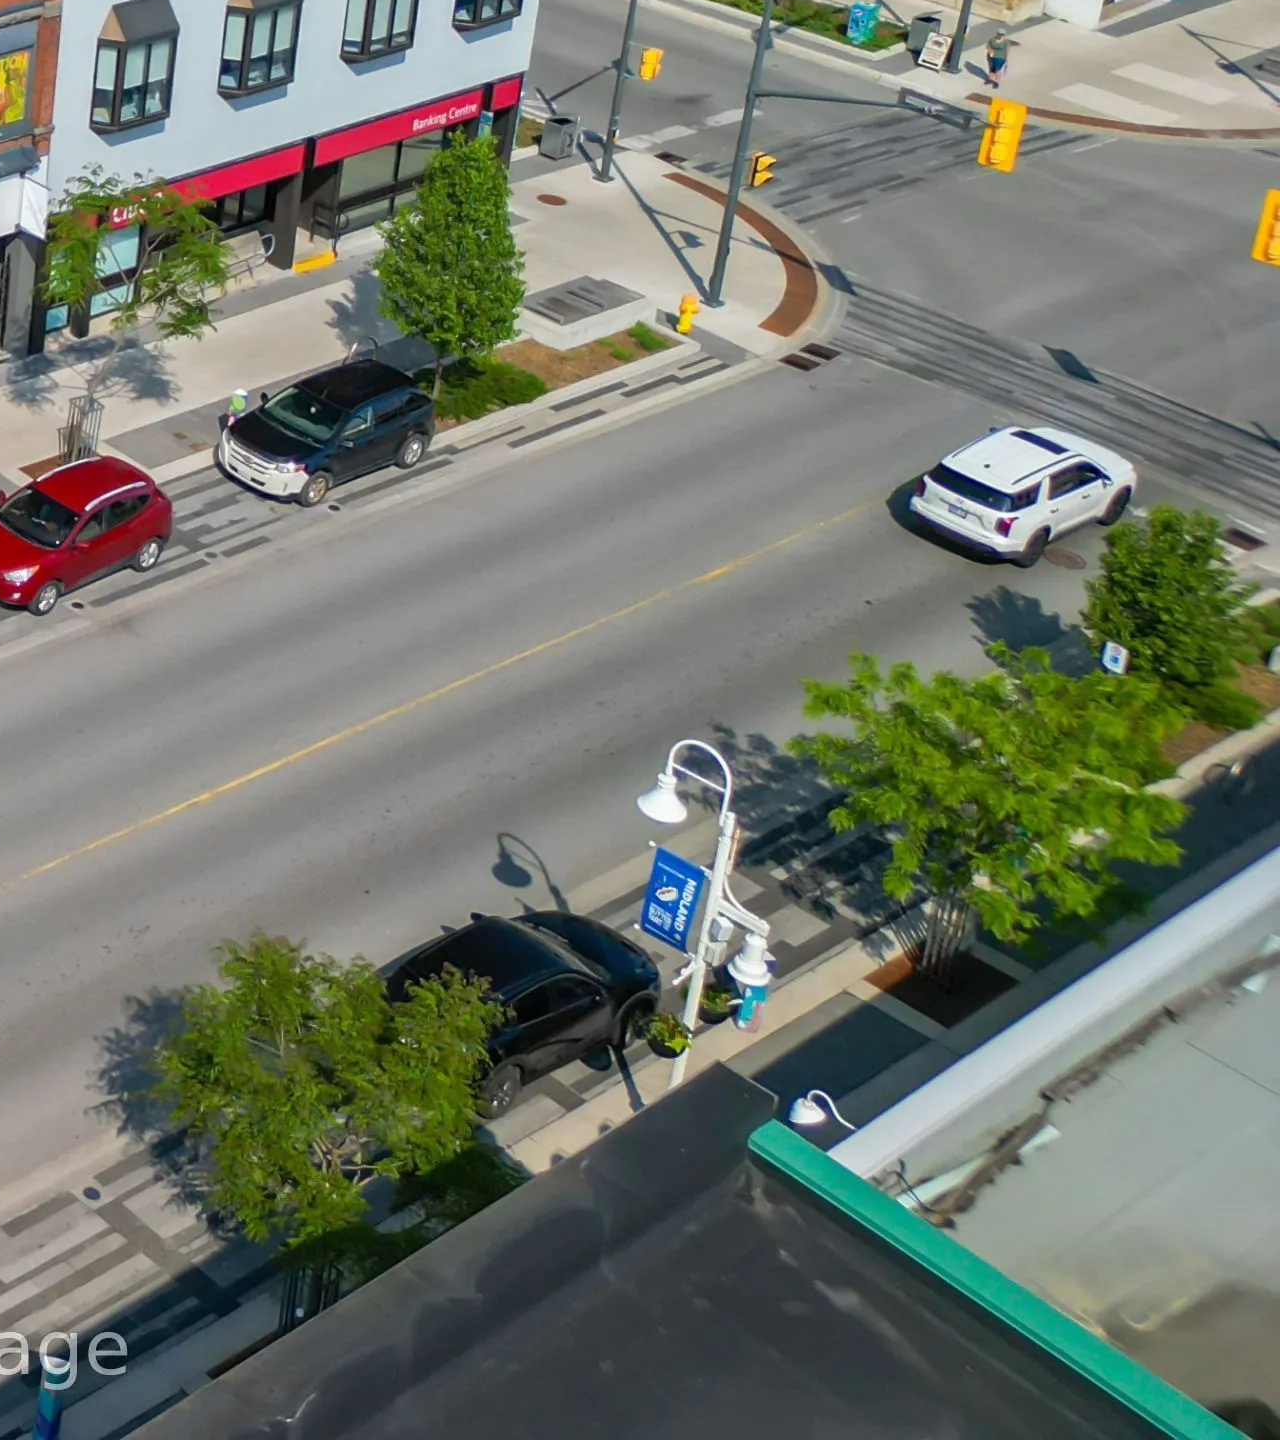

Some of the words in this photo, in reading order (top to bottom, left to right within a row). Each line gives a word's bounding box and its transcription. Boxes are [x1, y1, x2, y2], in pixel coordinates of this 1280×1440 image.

[413, 112, 447, 131] Banking
[449, 103, 478, 120] Centre
[674, 878, 698, 931] MIDLAND
